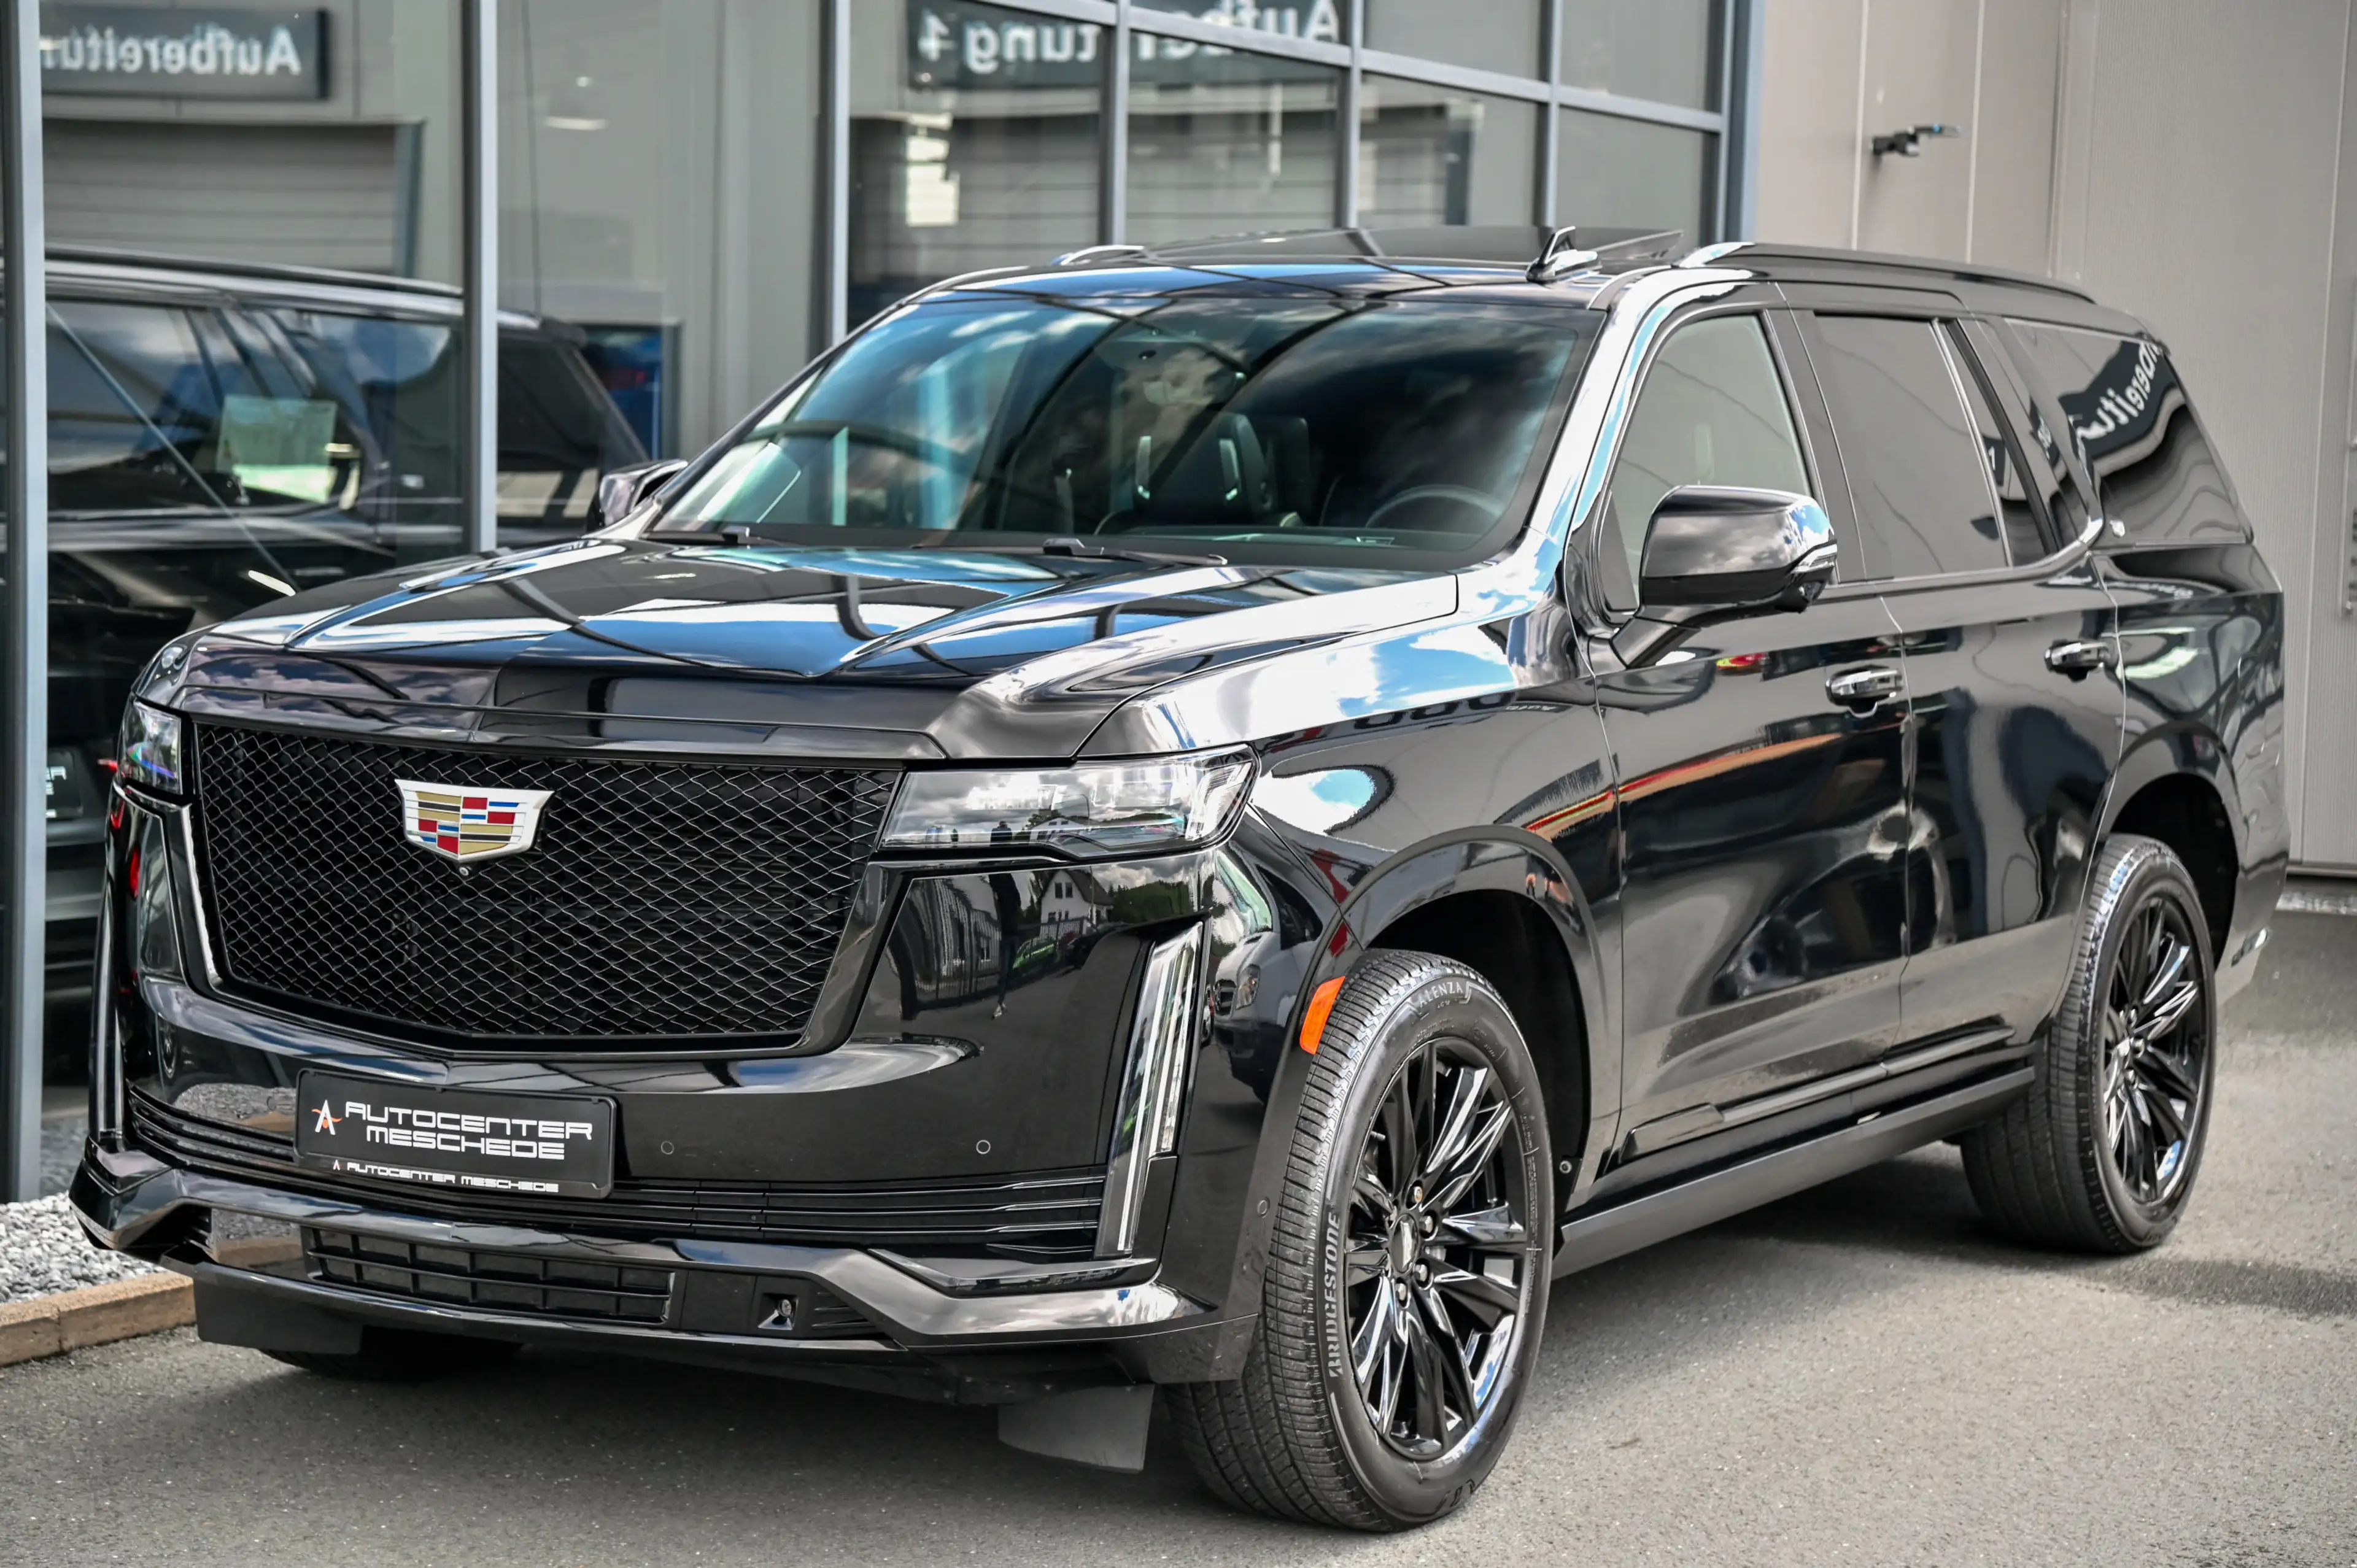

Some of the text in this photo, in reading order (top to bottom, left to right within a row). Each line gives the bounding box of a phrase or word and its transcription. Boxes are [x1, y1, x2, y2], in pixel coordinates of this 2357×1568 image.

[1419, 981, 1463, 1008] ALENZA
[345, 1101, 593, 1140] AUTOCENTER
[366, 1125, 565, 1160] MESCHEDE
[347, 1162, 456, 1184] AUTOCENTER
[460, 1175, 559, 1192] MESCHEDE
[1323, 1211, 1344, 1378] BRIDGESTONE
